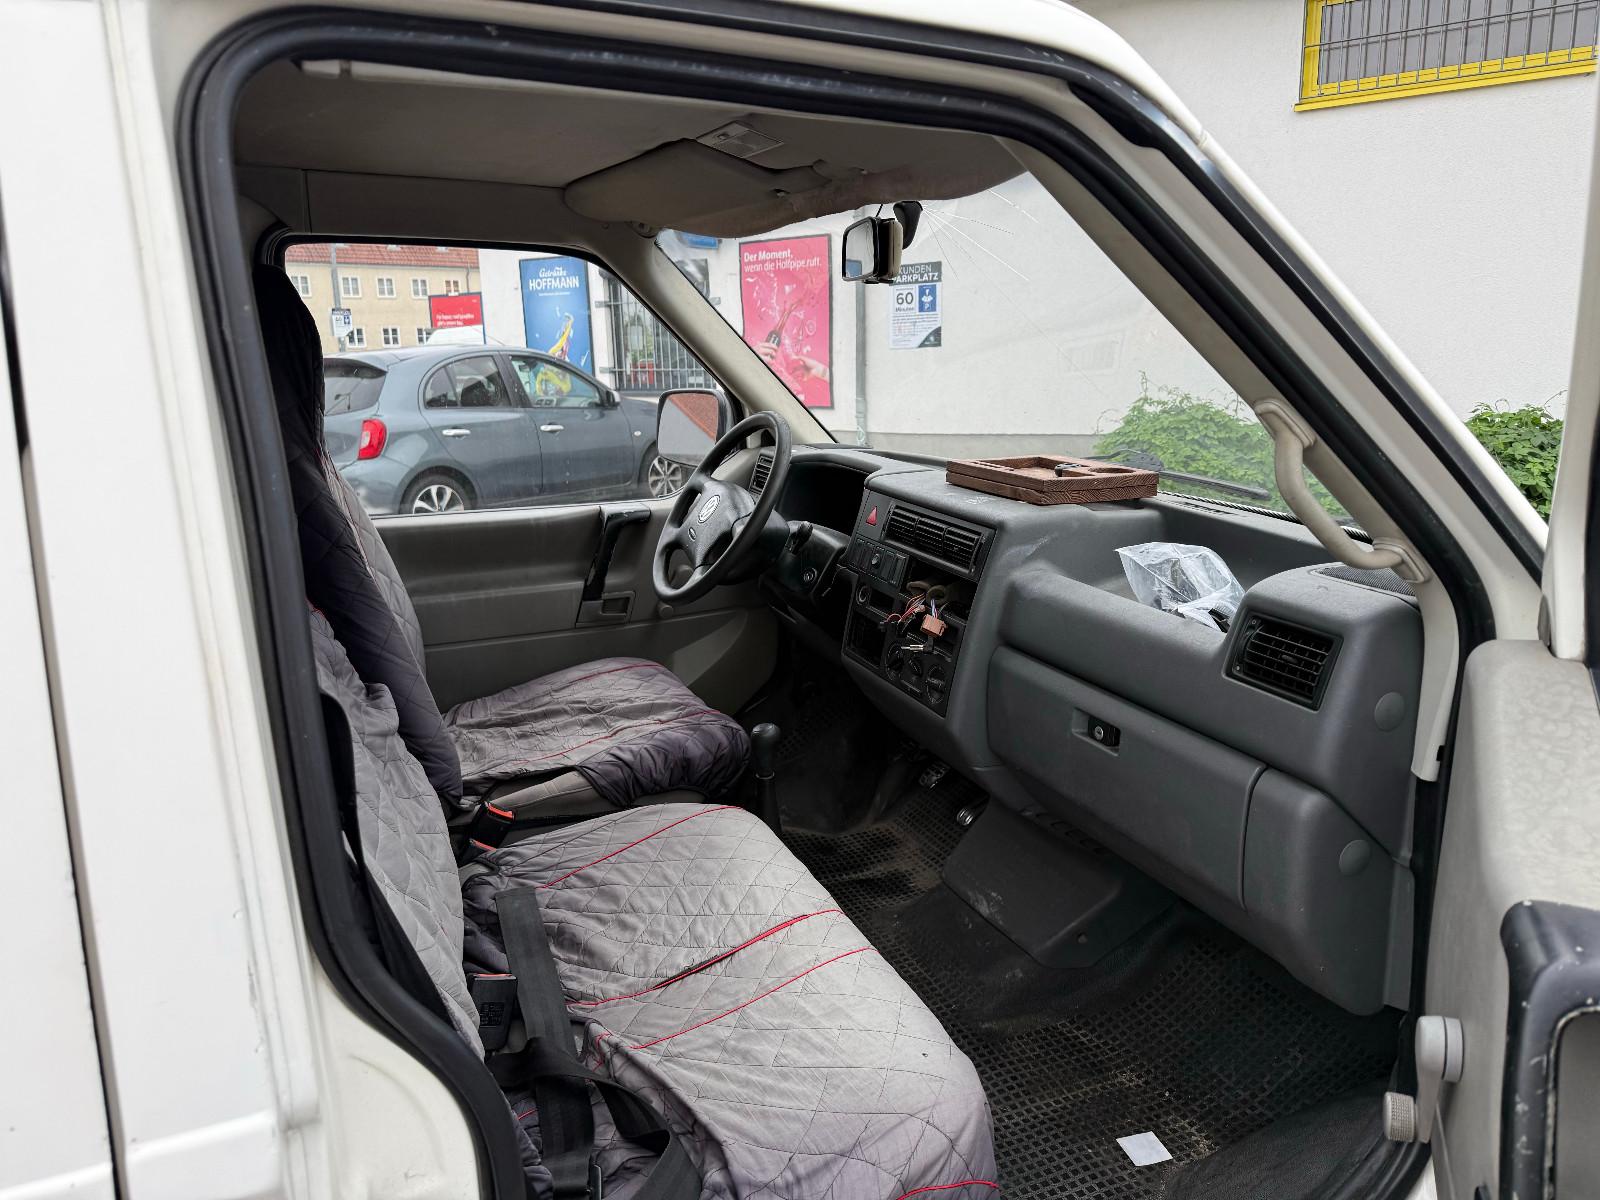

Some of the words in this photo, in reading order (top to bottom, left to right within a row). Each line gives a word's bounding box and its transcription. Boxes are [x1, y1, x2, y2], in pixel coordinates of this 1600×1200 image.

[744, 252, 757, 262] Der
[758, 249, 793, 261] Moment,
[744, 263, 763, 273] wenn
[764, 260, 775, 271] die
[529, 275, 580, 291] HOFFMANN
[896, 291, 914, 305] 60
